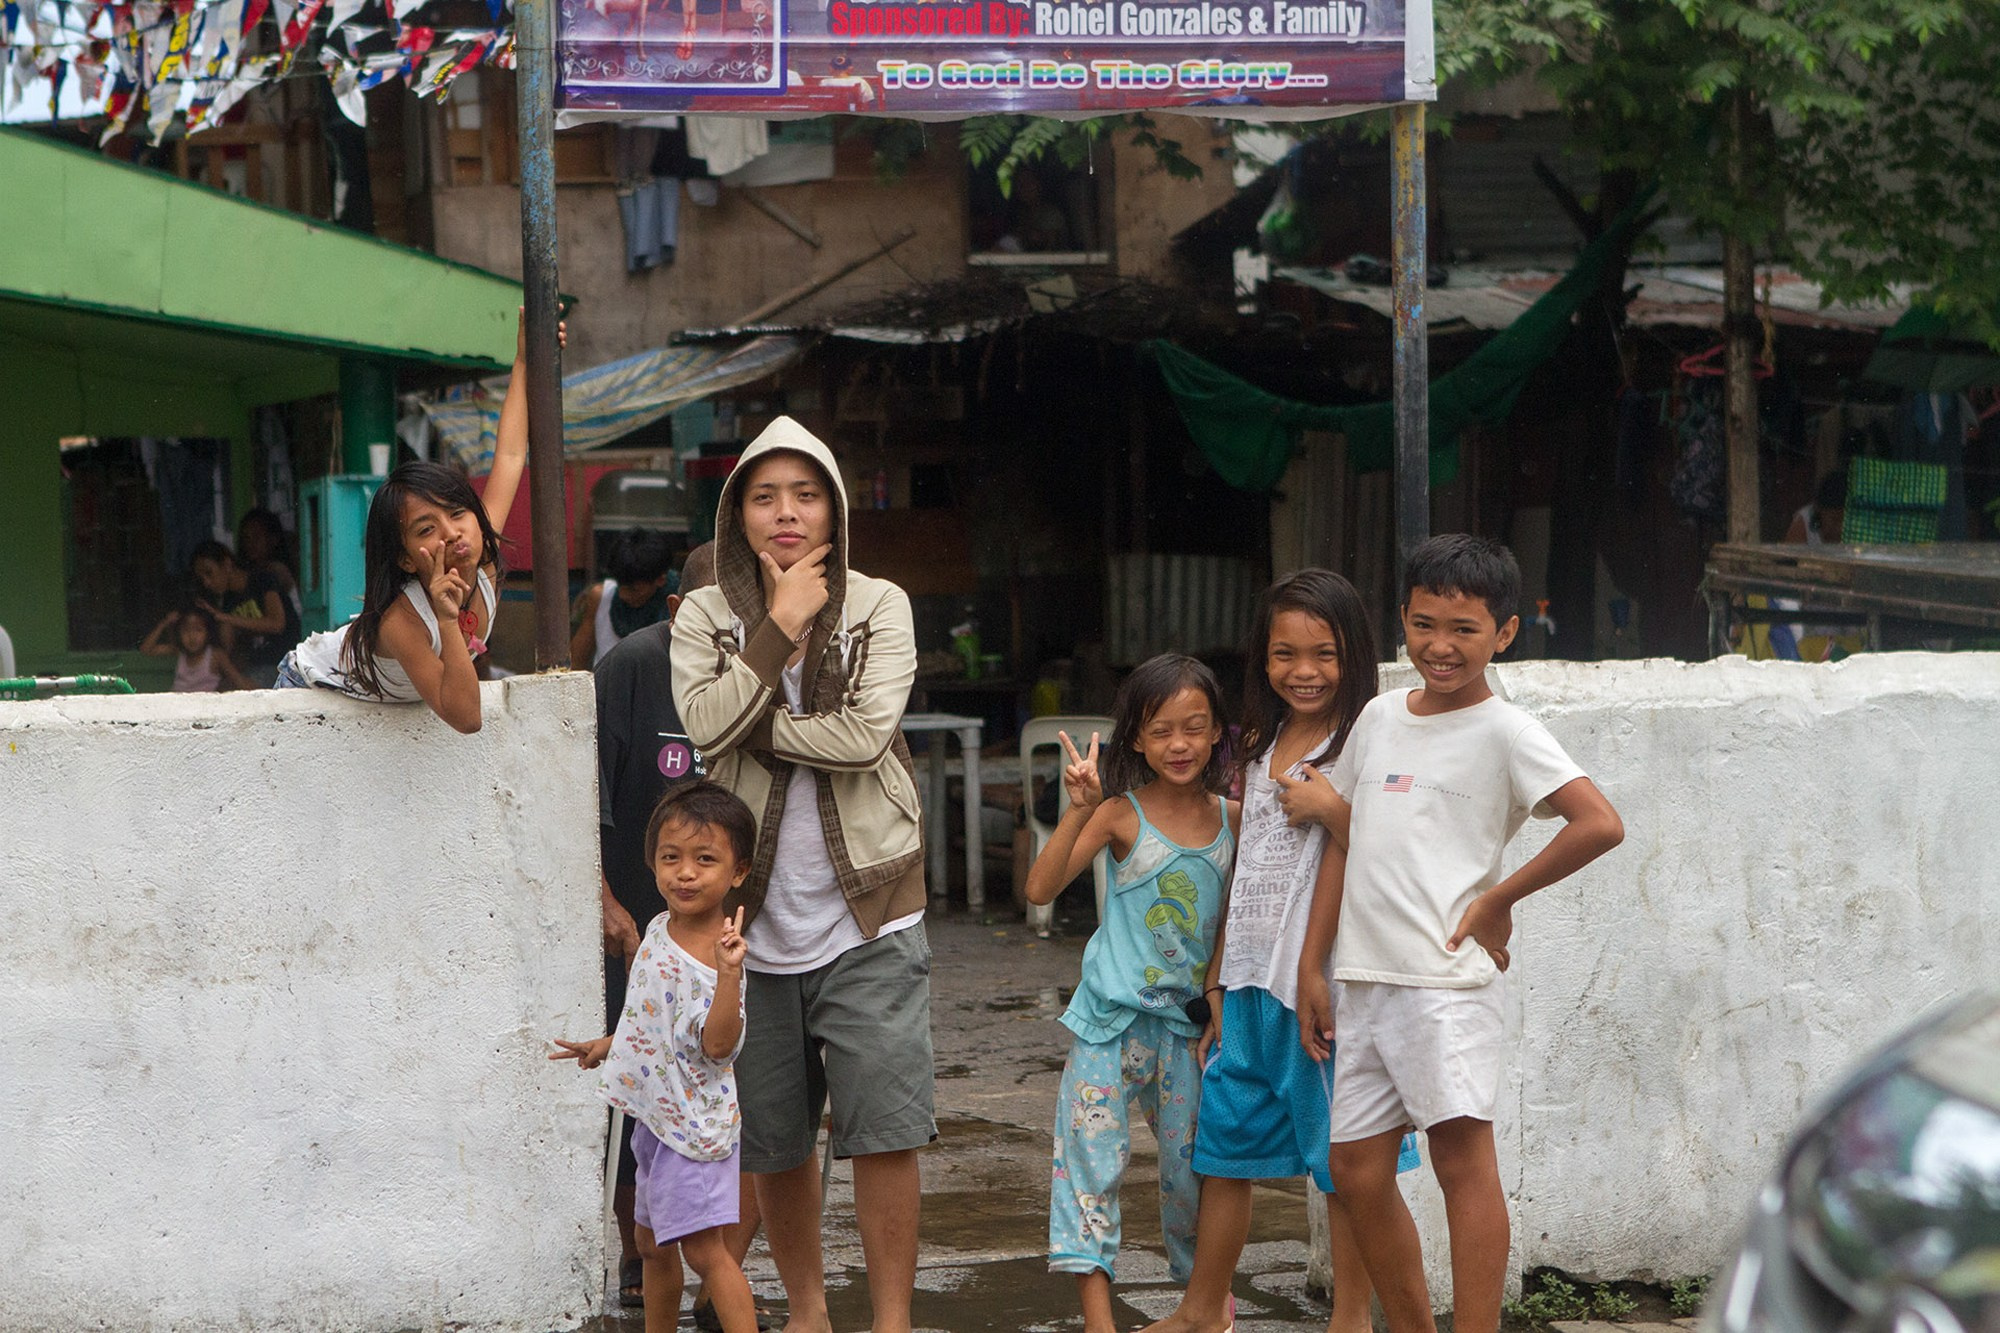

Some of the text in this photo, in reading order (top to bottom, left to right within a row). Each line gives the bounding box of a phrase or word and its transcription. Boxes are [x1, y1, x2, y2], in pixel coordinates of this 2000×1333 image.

[832, 1, 1363, 44] Sponsored By: Rohel Gonzales & Family
[878, 60, 933, 90] To
[937, 59, 1024, 90] God
[1030, 60, 1087, 89] Be
[1093, 60, 1174, 89] The
[667, 751, 682, 769] H
